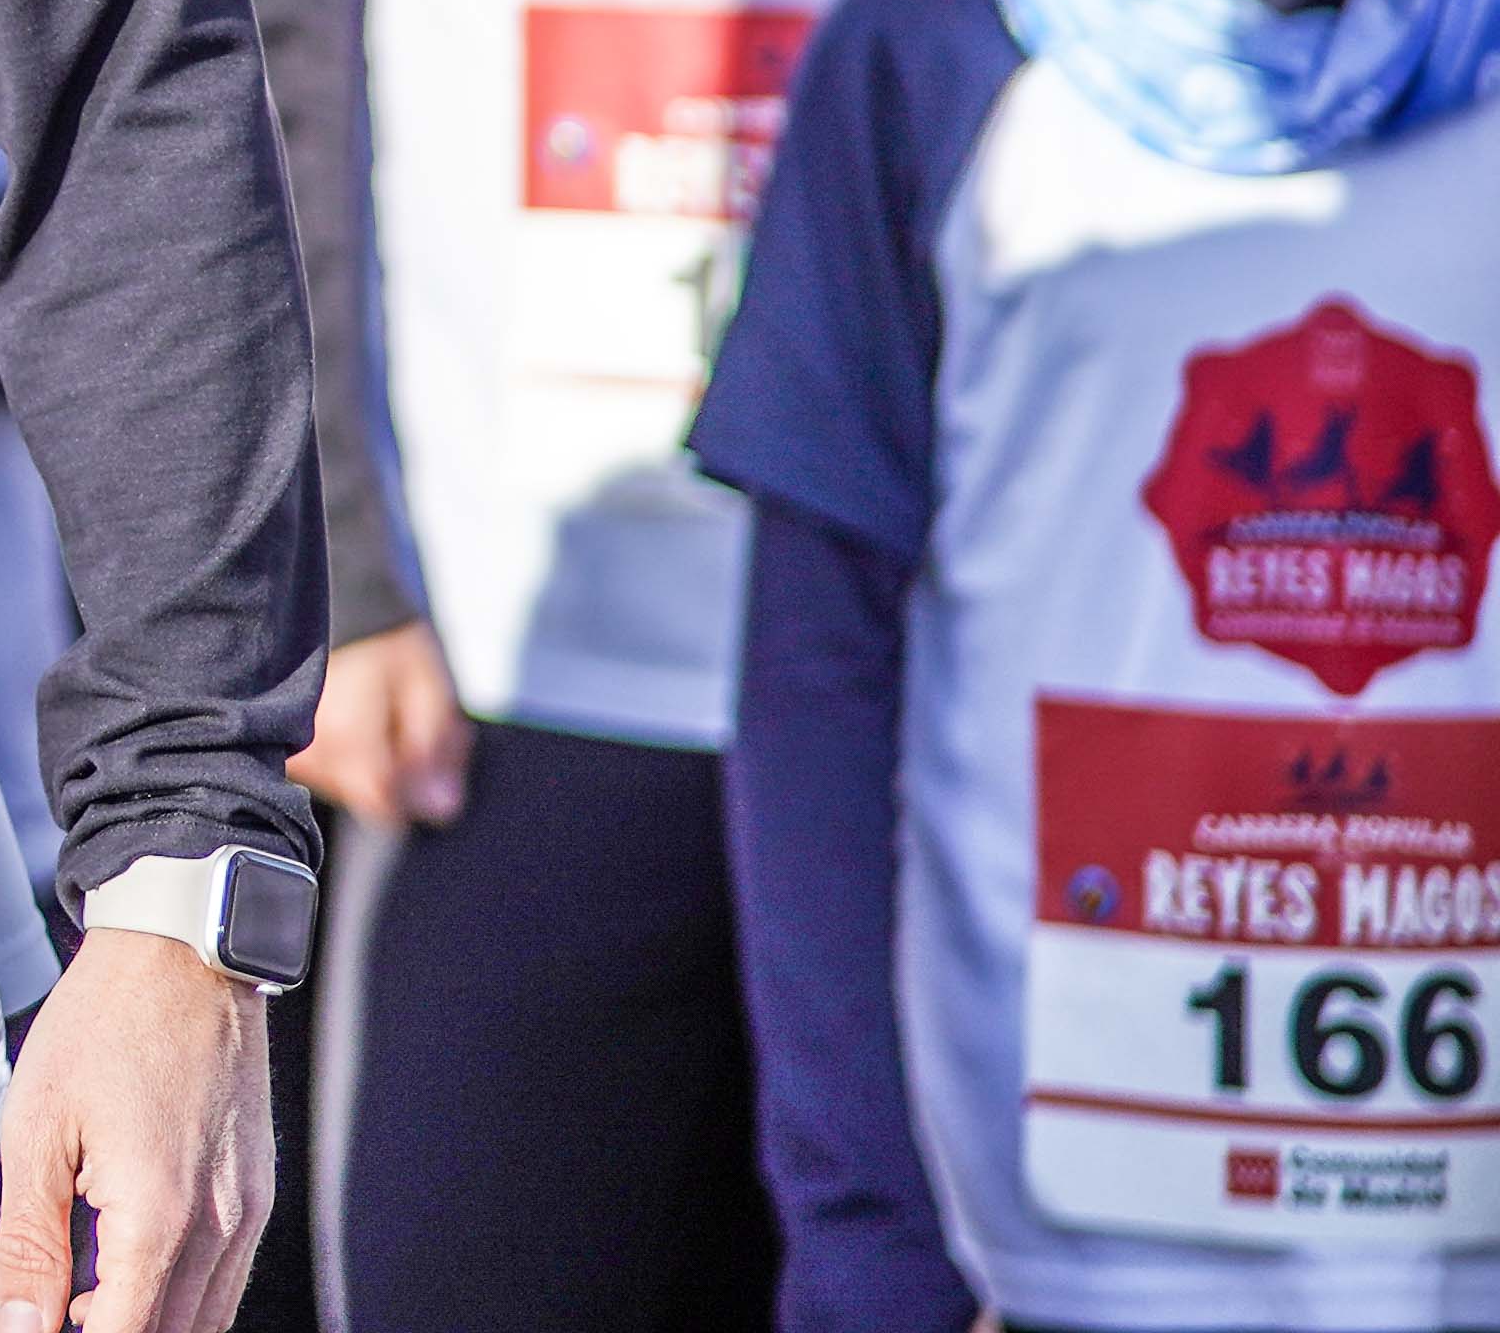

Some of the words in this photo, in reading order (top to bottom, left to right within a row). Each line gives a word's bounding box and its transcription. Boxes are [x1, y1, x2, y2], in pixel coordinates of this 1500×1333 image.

[1206, 545, 1331, 610] REYES
[1194, 812, 1340, 852] CARRERA
[1143, 849, 1319, 938] REYES
[1340, 861, 1500, 945] MAGOS
[1186, 957, 1484, 1098] 166
